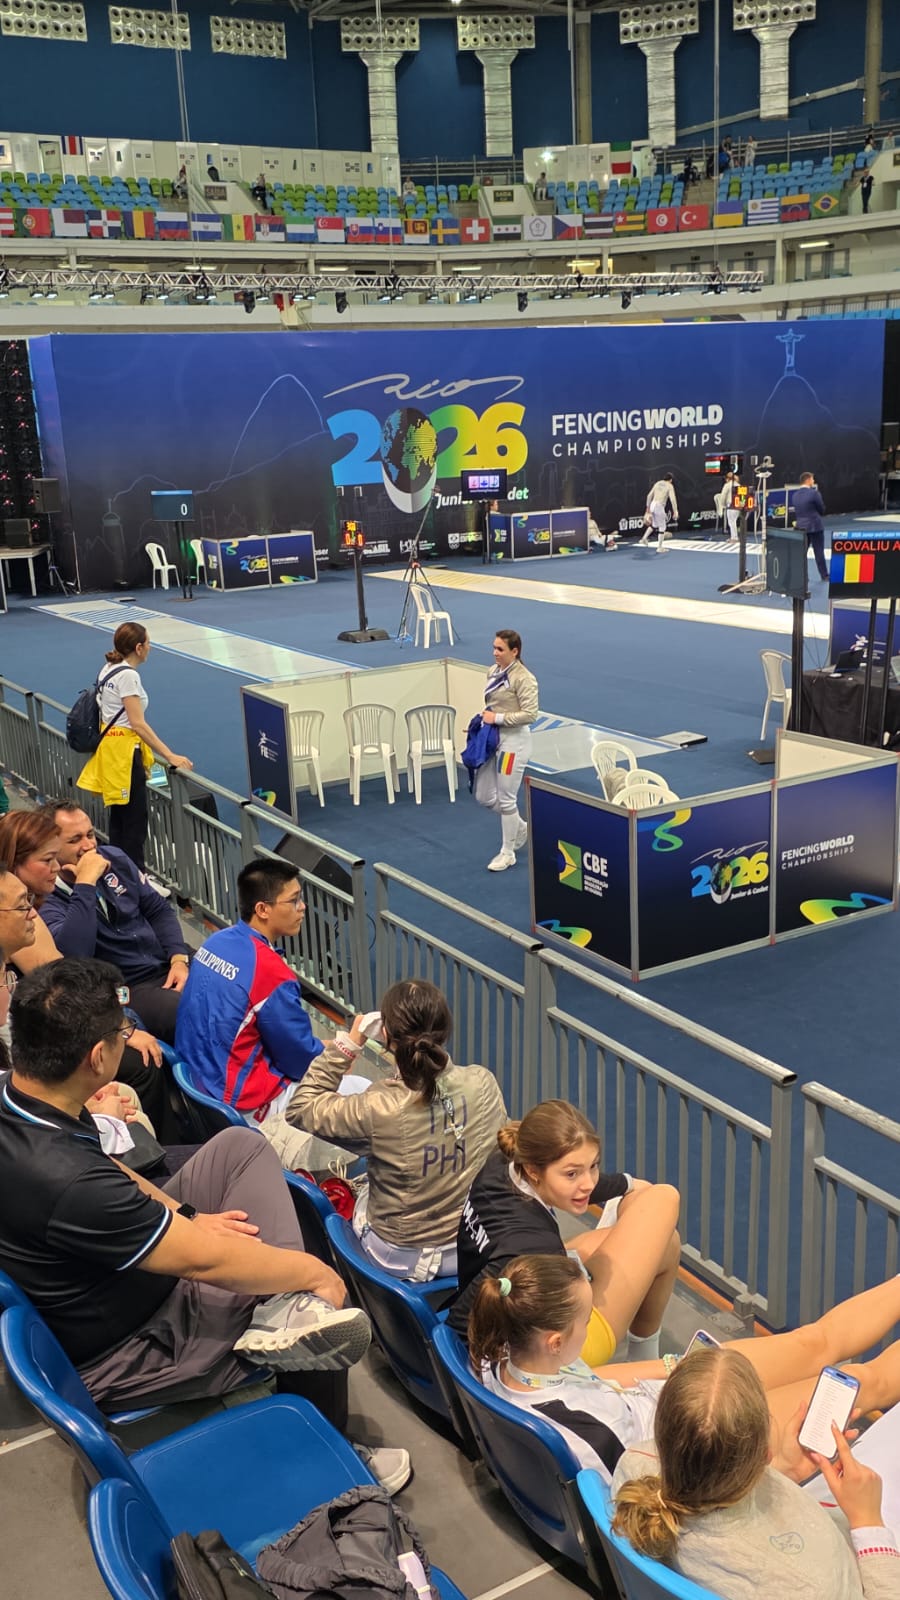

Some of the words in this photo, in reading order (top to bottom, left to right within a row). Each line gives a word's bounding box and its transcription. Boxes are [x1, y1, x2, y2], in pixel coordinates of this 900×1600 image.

[327, 402, 529, 494] 2026
[552, 431, 723, 458] CHAMPIONSHIPS
[181, 503, 188, 516] 0
[834, 540, 890, 552] COVALIU
[583, 851, 609, 878] CBE
[781, 846, 855, 870] CHAMPIONSHIPS
[422, 1138, 467, 1177] PHI
